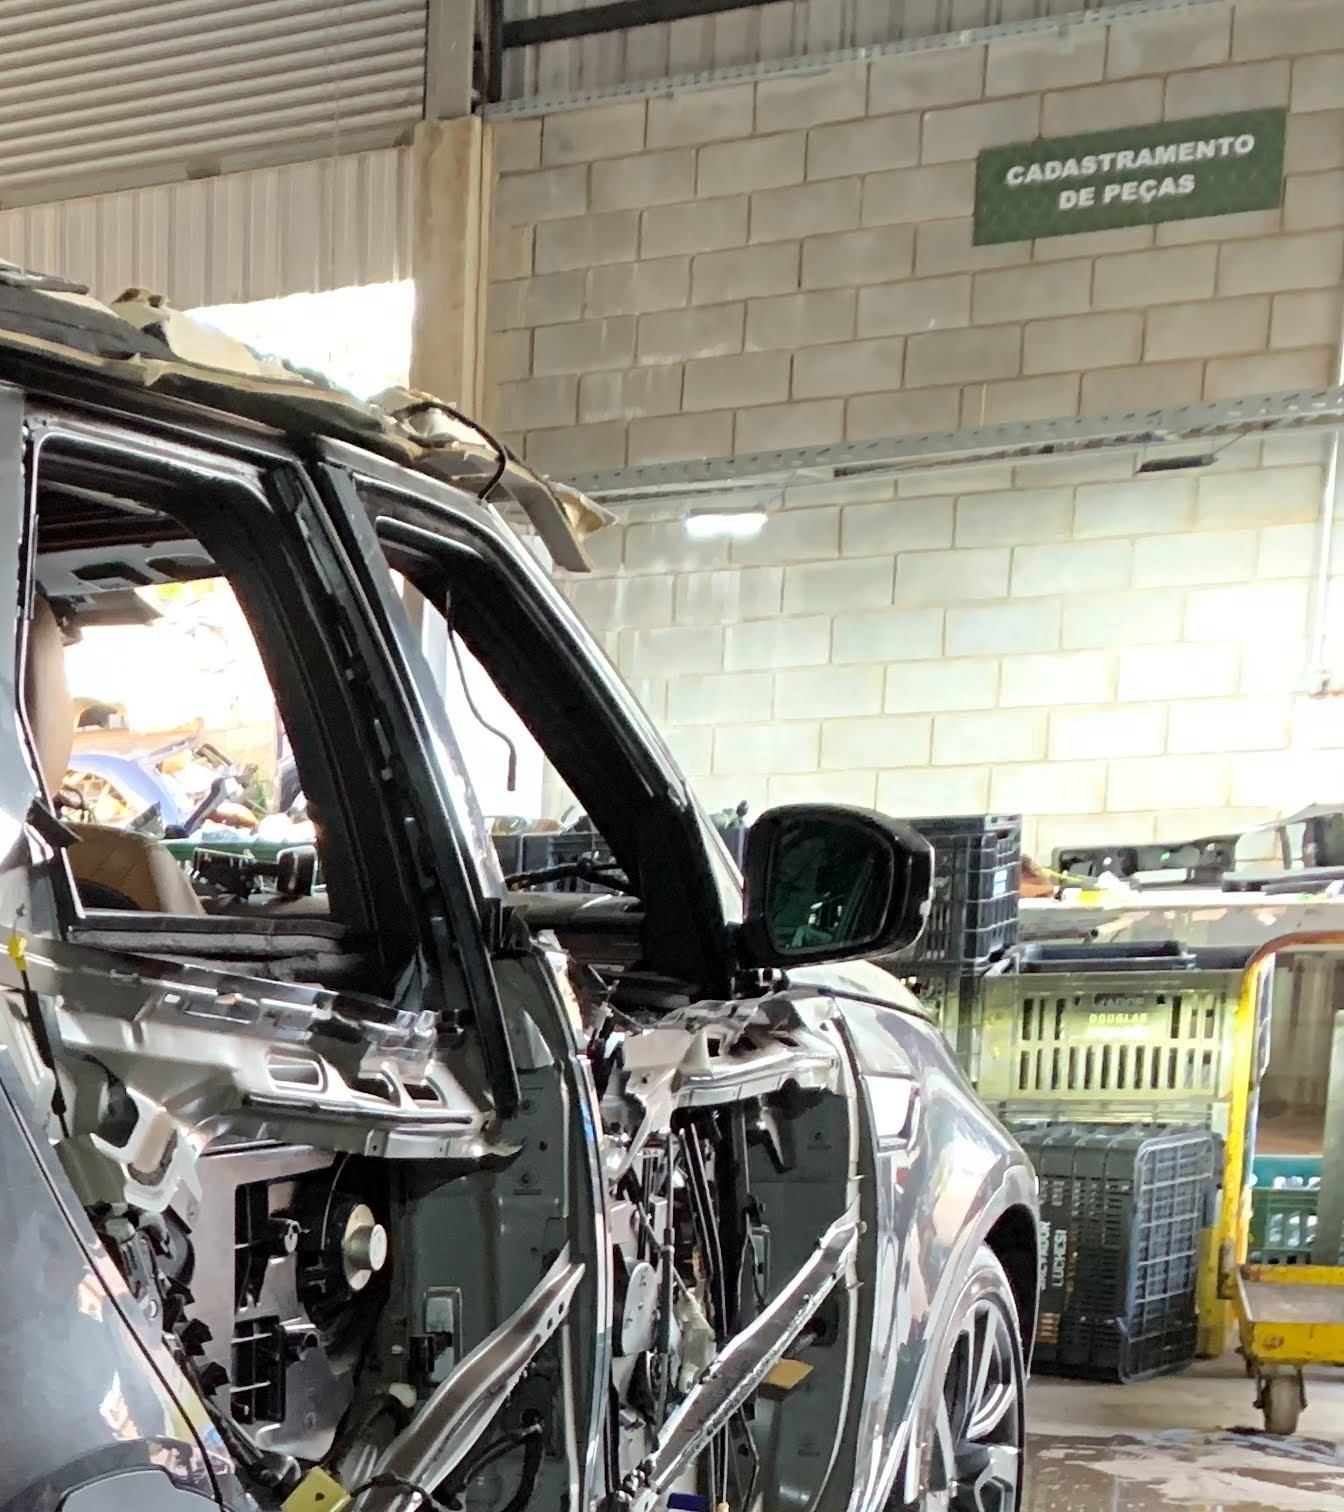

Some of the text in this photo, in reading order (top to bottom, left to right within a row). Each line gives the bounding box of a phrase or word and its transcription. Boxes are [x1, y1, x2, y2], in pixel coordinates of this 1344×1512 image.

[1005, 133, 1255, 186] CADASTRAMENTO
[1058, 173, 1195, 211] DE PEÇAS
